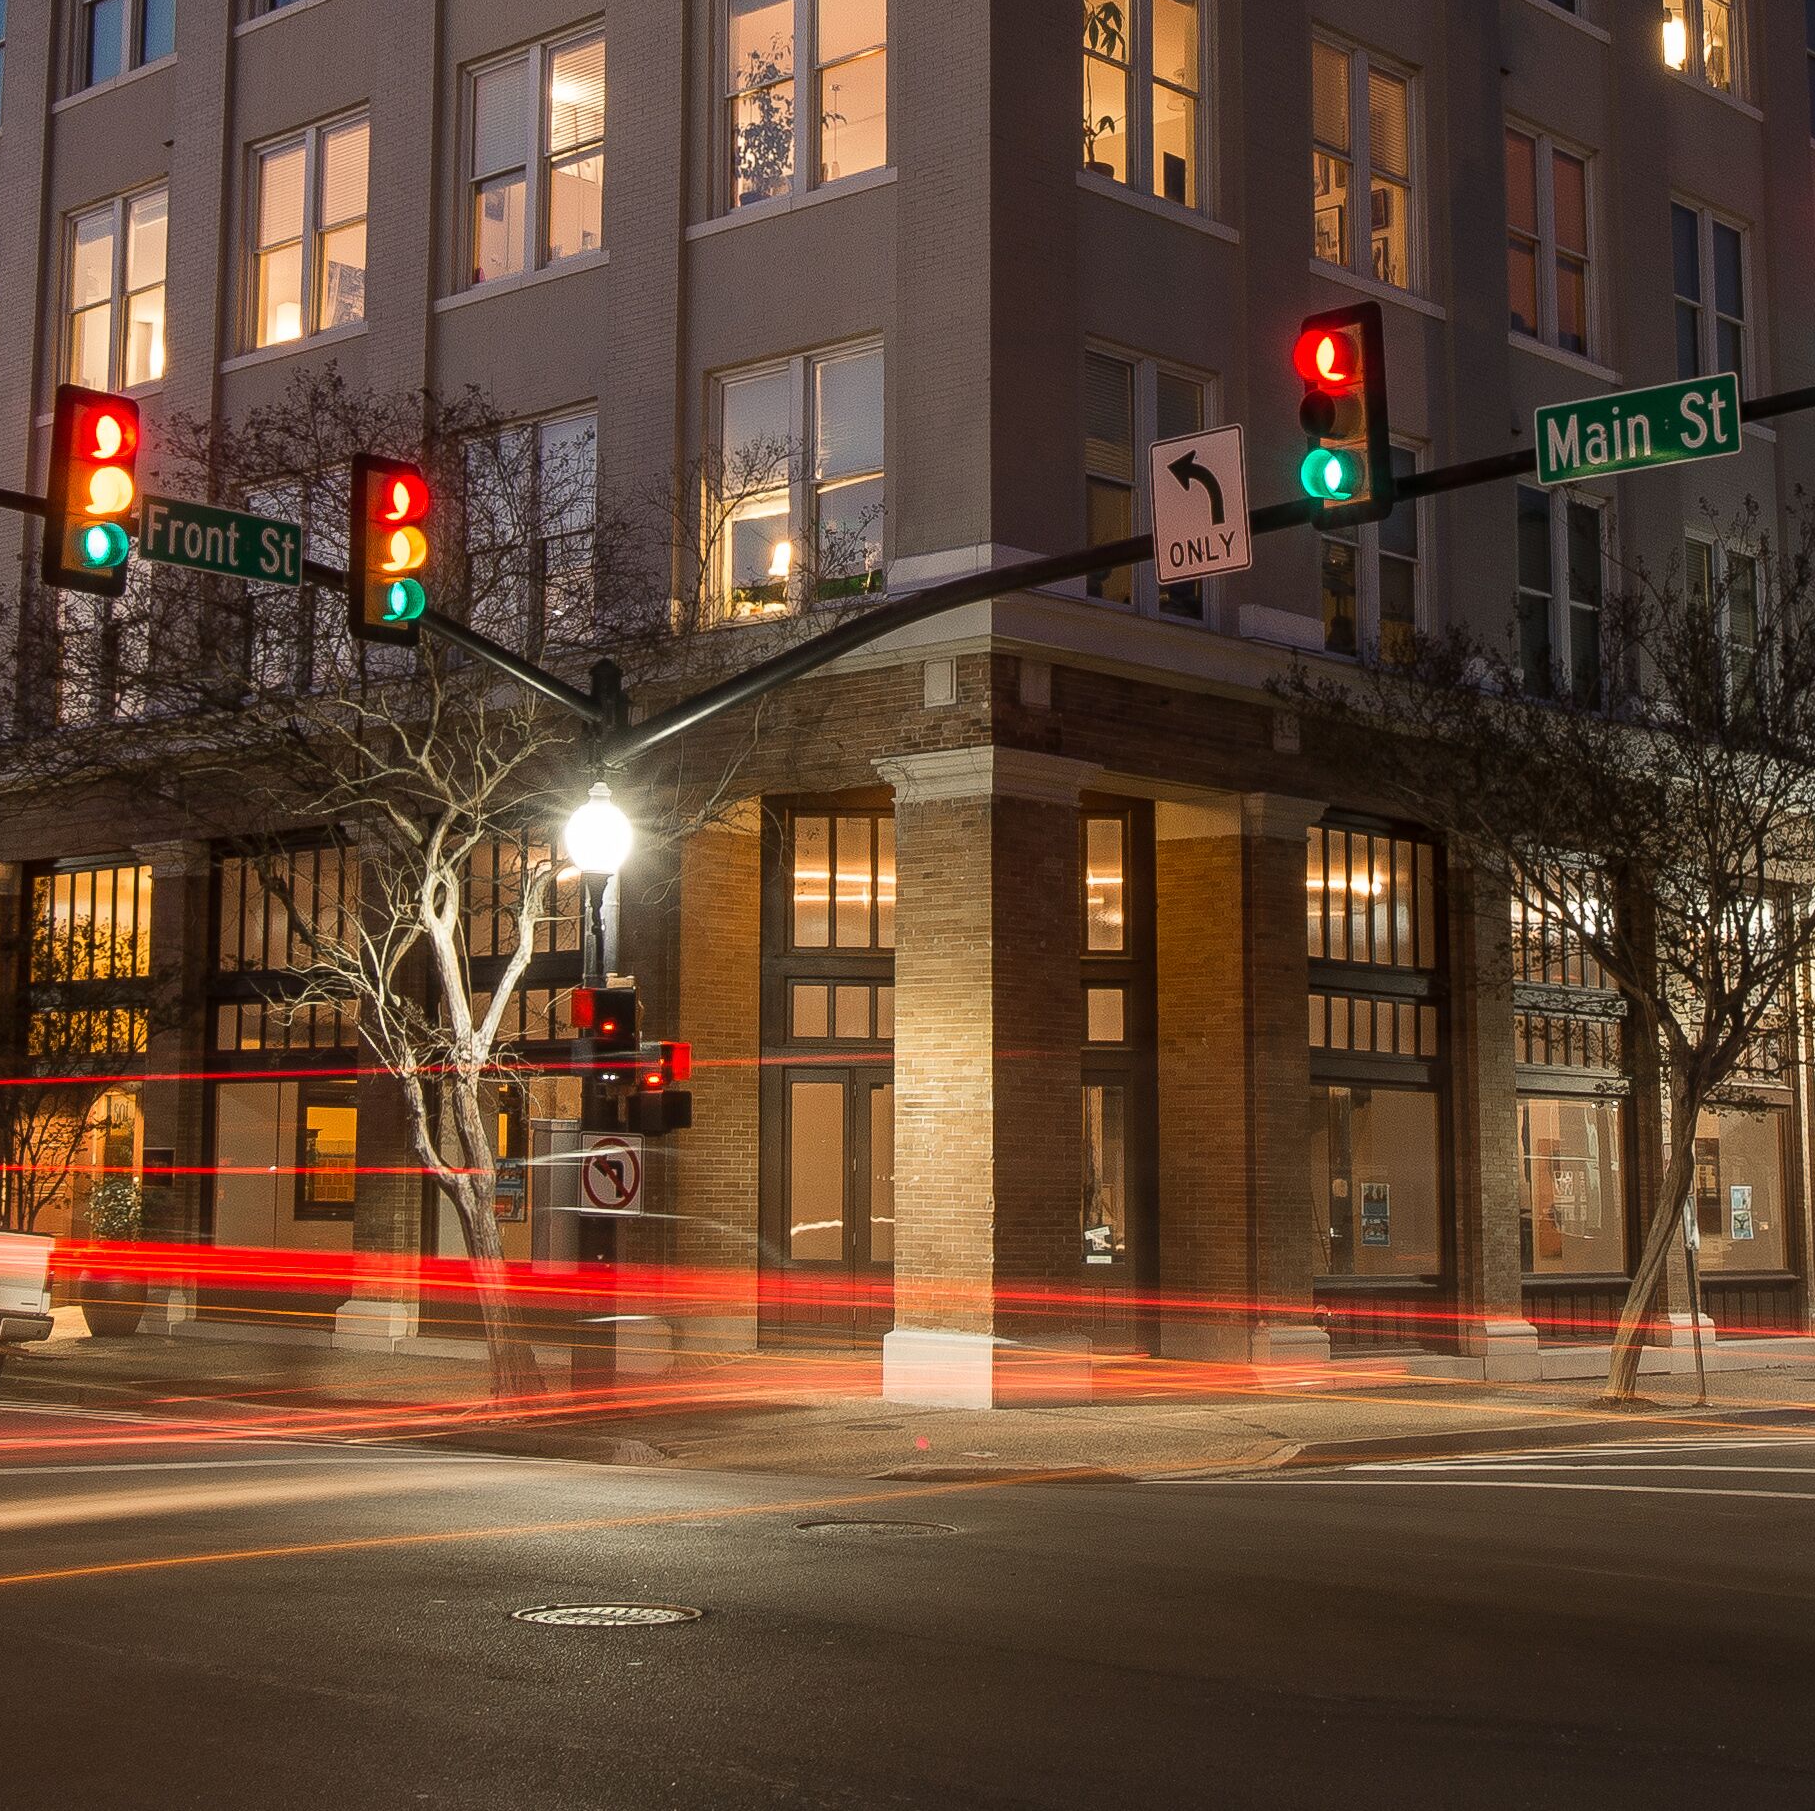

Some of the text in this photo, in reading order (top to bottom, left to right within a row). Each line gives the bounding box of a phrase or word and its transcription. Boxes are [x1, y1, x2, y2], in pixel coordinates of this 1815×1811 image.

[1546, 387, 1730, 473] Main St
[145, 504, 297, 578] Front St
[1167, 527, 1238, 570] ONLY
